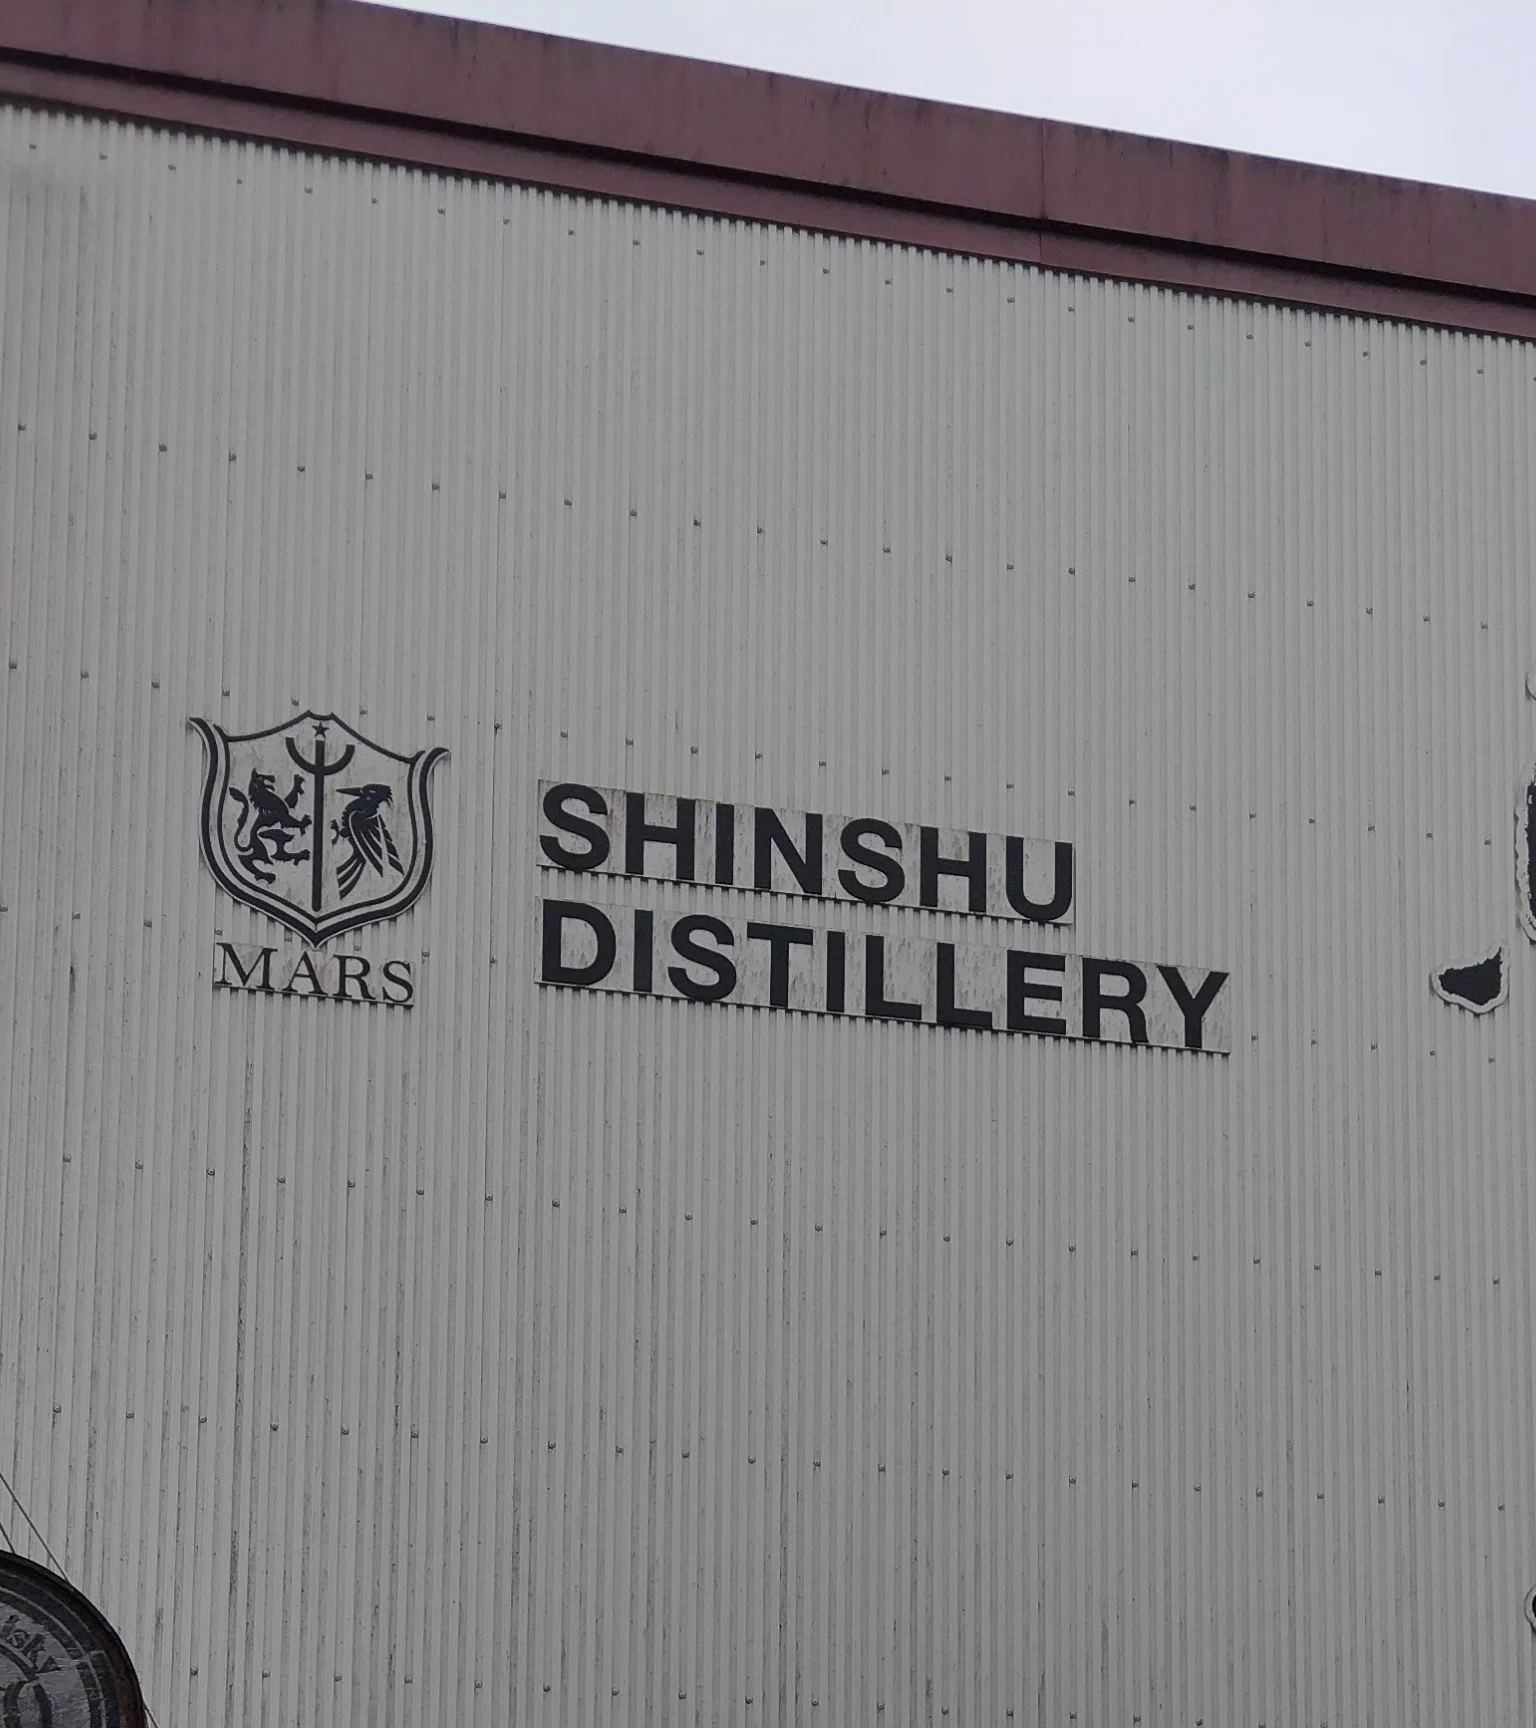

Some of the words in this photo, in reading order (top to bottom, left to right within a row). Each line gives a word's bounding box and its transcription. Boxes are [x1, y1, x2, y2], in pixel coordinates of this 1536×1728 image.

[538, 782, 1073, 921] SHINSHU
[216, 940, 415, 1004] MARS
[541, 898, 1230, 1049] DISTILLERY
